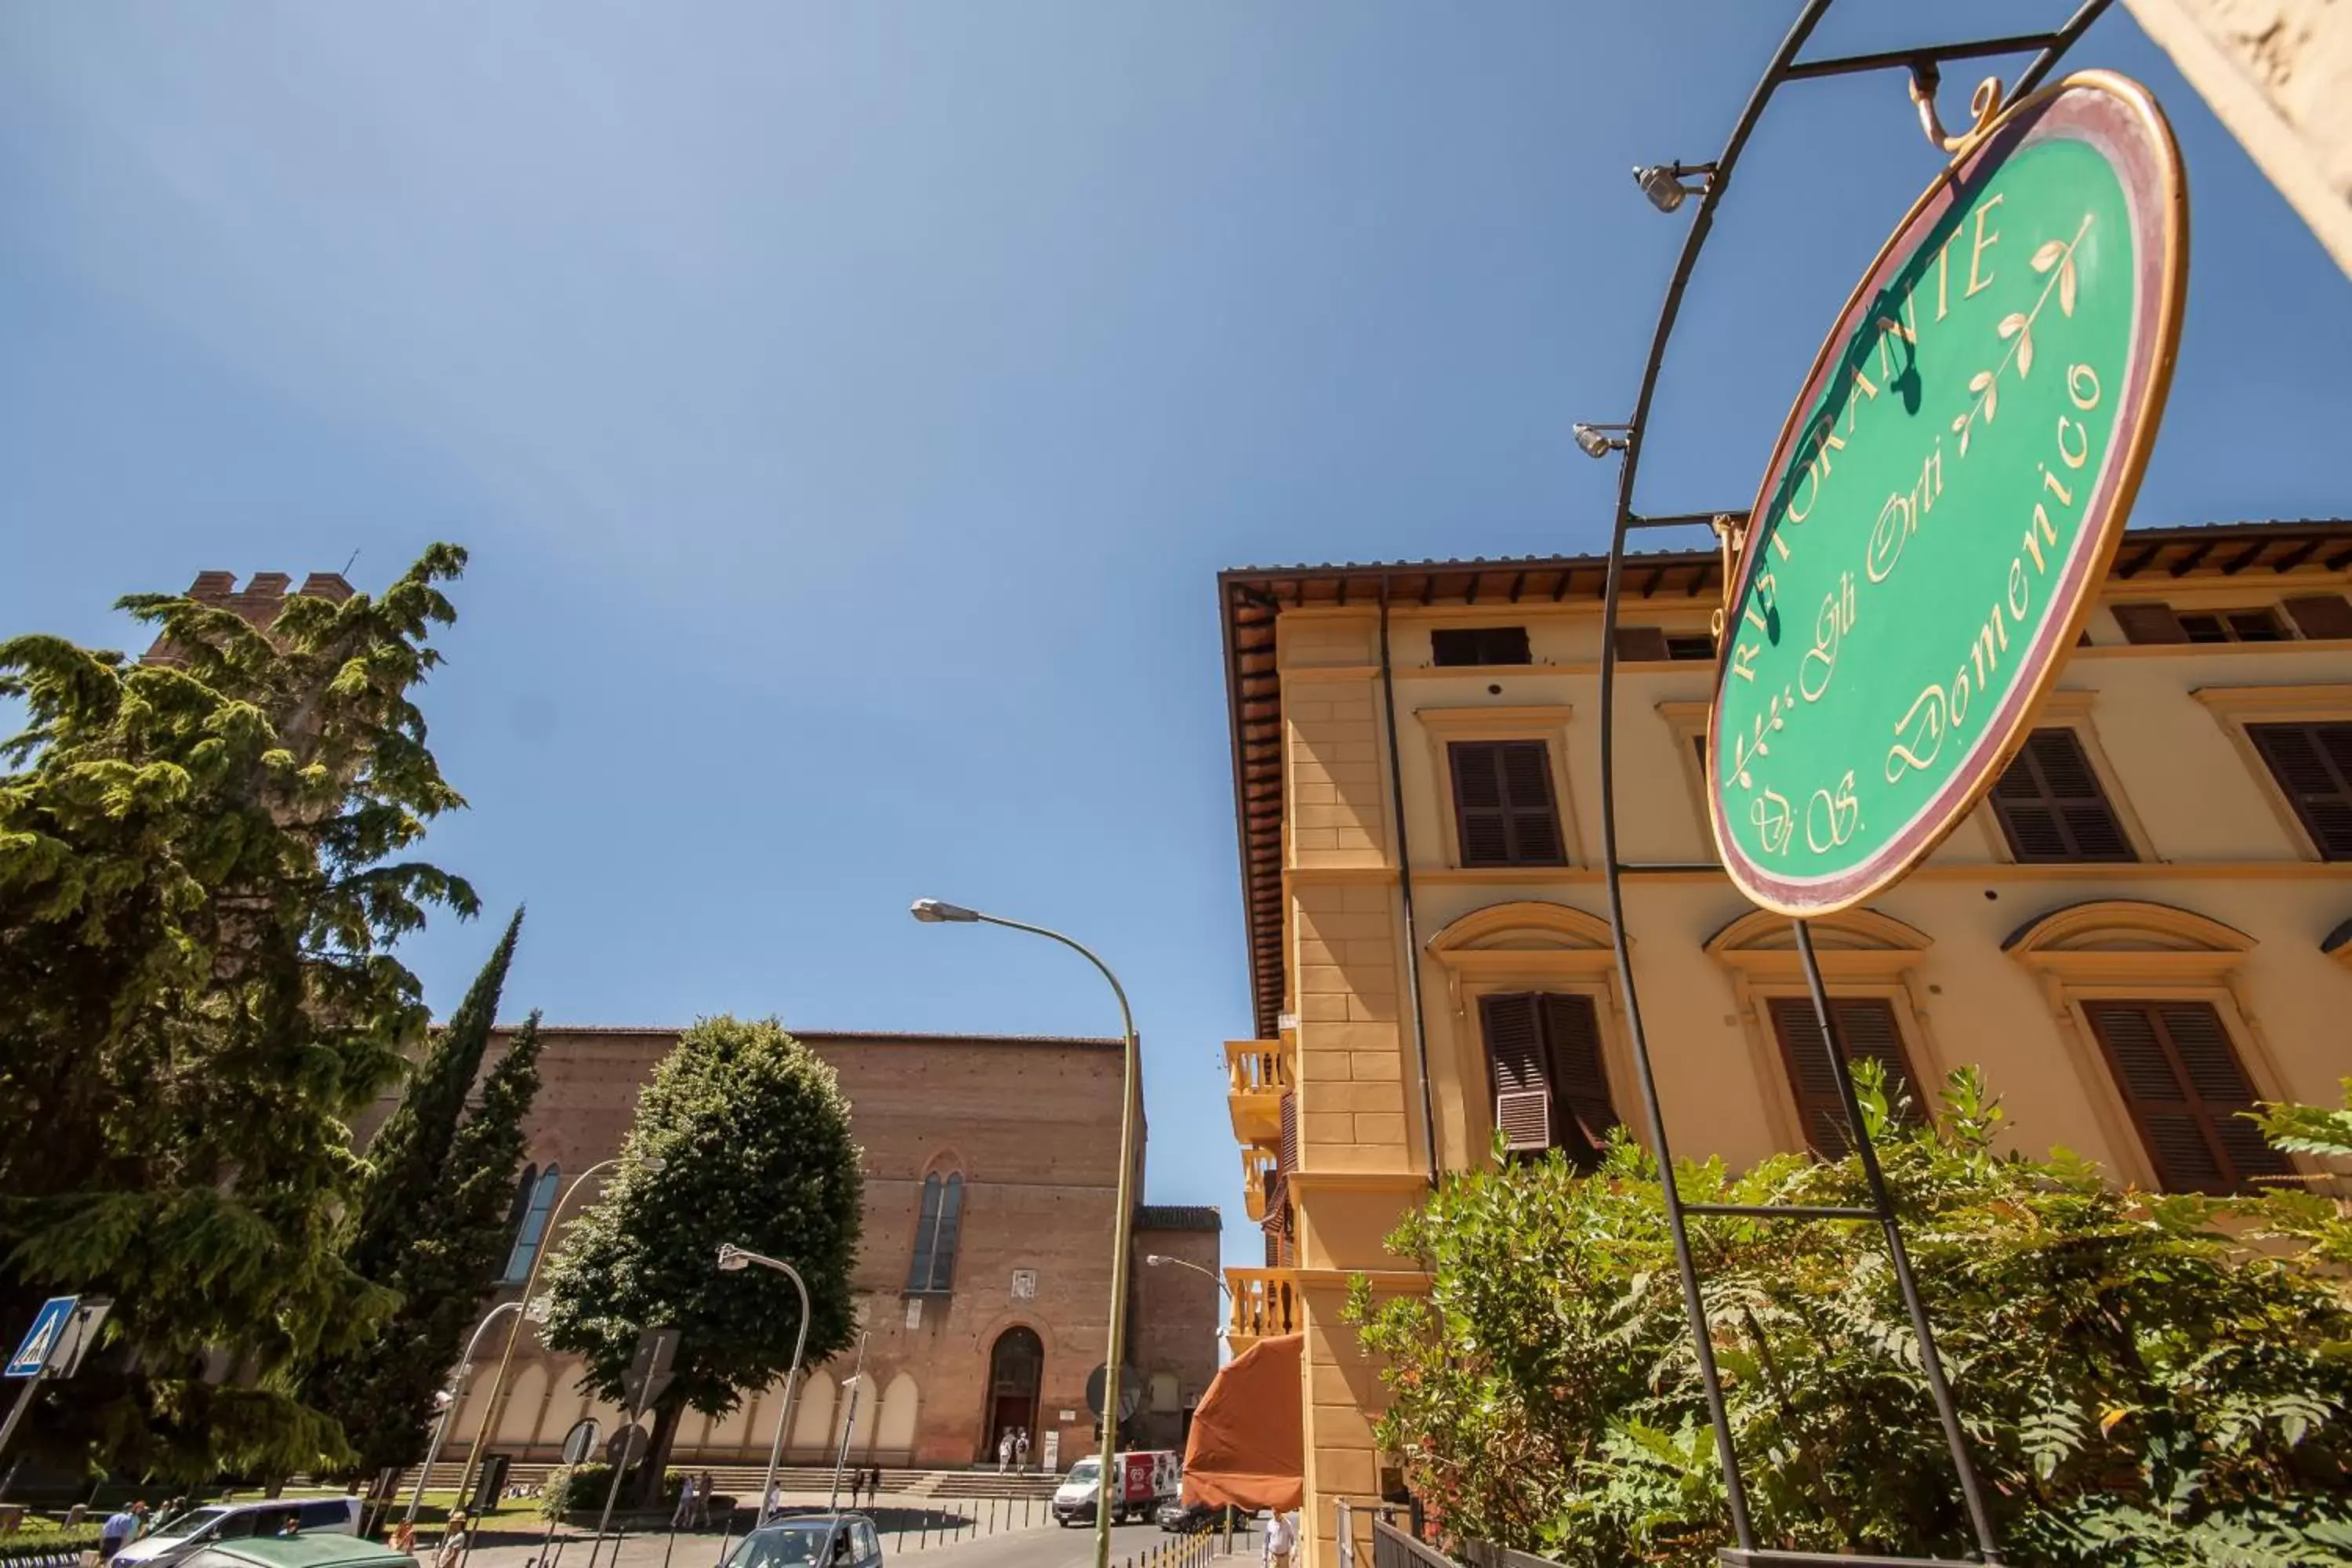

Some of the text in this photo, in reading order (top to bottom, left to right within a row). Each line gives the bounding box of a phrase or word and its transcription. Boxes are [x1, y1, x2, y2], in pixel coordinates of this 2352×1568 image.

[1733, 192, 2005, 683] RISTORANTE
[1799, 435, 1944, 702] Gli Orti
[1886, 363, 2102, 784] Domenico
